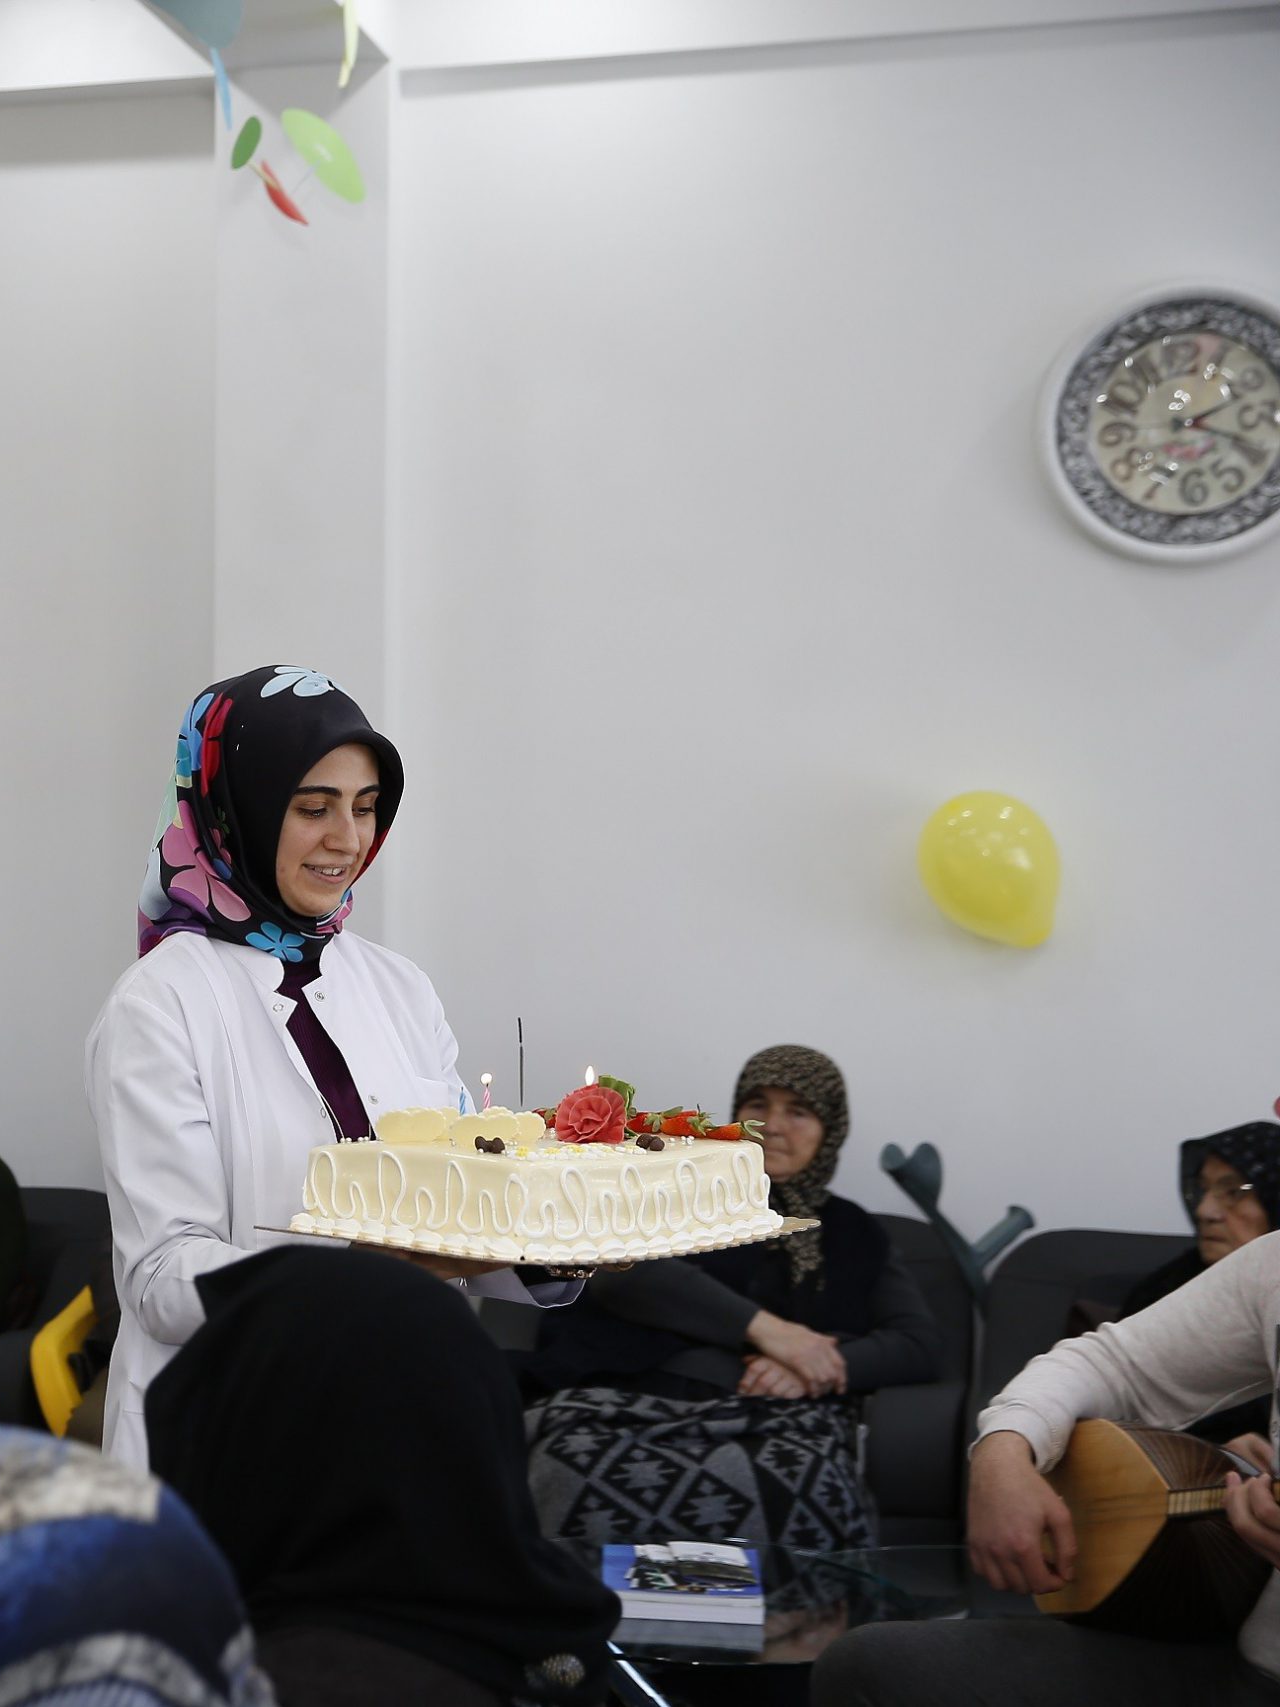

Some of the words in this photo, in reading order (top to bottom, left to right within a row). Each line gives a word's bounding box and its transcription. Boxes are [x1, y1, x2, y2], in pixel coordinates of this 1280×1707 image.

[1098, 420, 1137, 448] 9
[1110, 446, 1146, 484] 8
[1210, 458, 1246, 493] 5
[1179, 468, 1209, 507] 6
